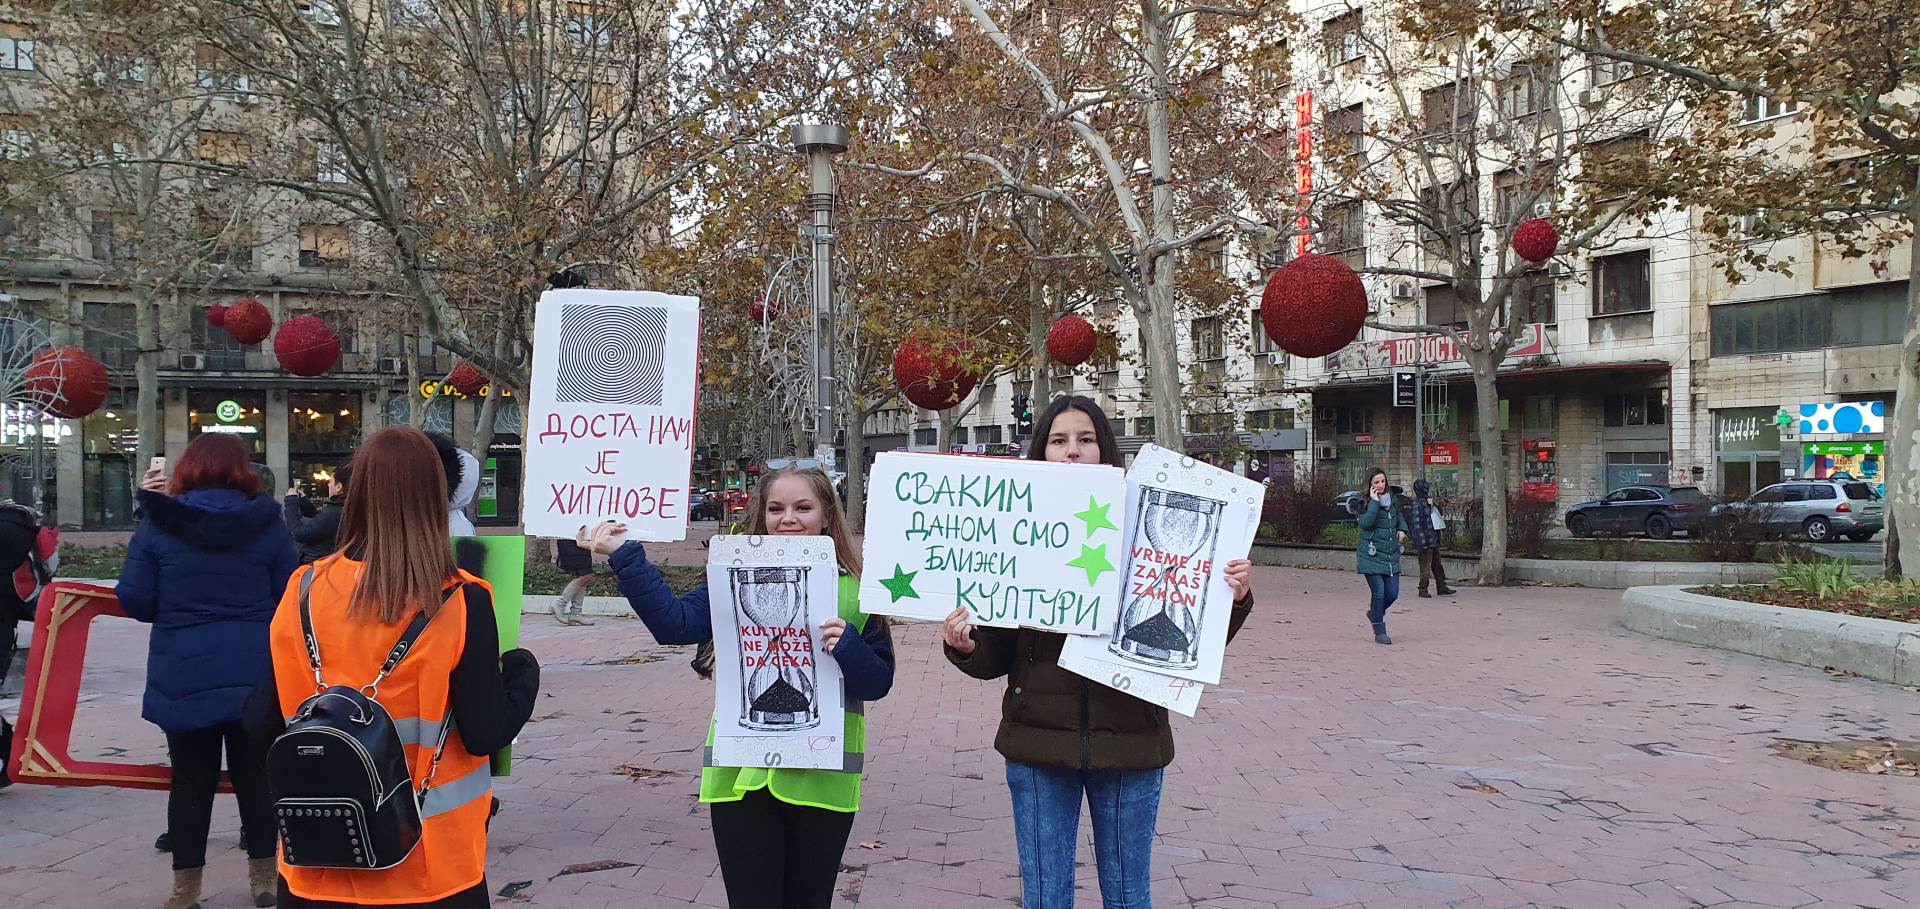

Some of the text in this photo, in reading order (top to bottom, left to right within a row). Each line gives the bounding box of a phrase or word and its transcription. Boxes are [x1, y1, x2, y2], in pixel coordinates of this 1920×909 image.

[540, 413, 691, 450] ДОСТА НАМ
[547, 482, 679, 519] ХИПНОЗЕ
[895, 471, 1033, 512] СВАКИМ
[905, 510, 1069, 548] ДАНОМ СМО
[924, 545, 1017, 579] БЛИЖИ
[1131, 546, 1212, 575] VREME JE
[1134, 564, 1201, 590] ZA NAŠ
[956, 577, 1101, 631] КУЛТУРИ
[1131, 582, 1197, 608] ZAKON
[741, 625, 809, 638] KULTURA
[743, 638, 811, 652] NE MOŽE
[745, 653, 812, 667] DA ČEKA
